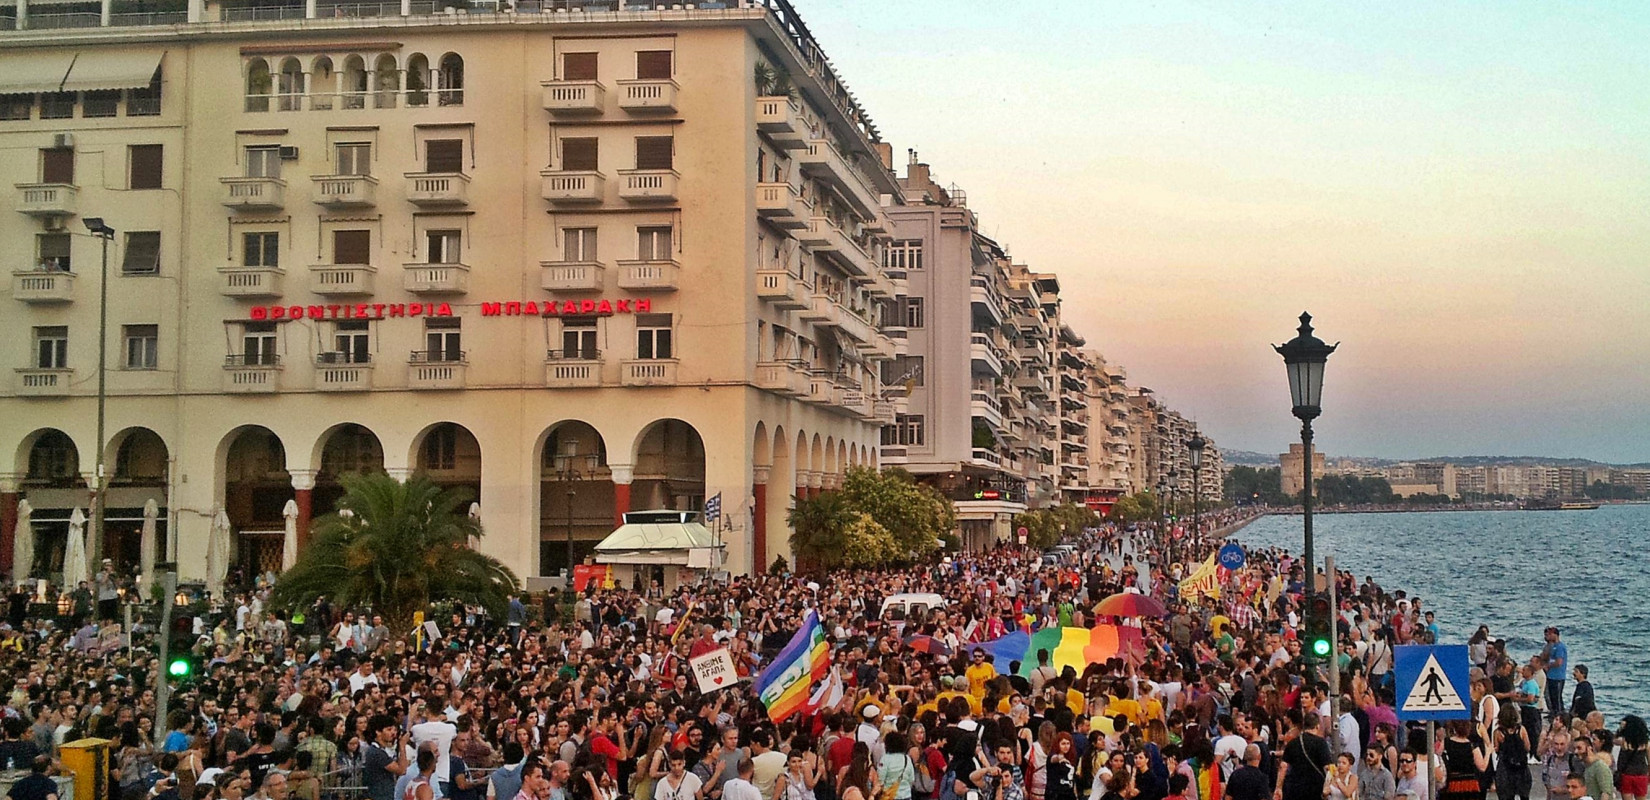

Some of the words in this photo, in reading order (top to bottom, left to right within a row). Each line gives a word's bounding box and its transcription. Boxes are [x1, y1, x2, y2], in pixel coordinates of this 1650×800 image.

[251, 303, 453, 320] ΦΡΟΝΤΙΣΤΗΡΙΑ
[481, 299, 651, 316] ΜΠΑΧΑΡΑΚΗ
[702, 665, 726, 679] ΑΓΑΠΑ
